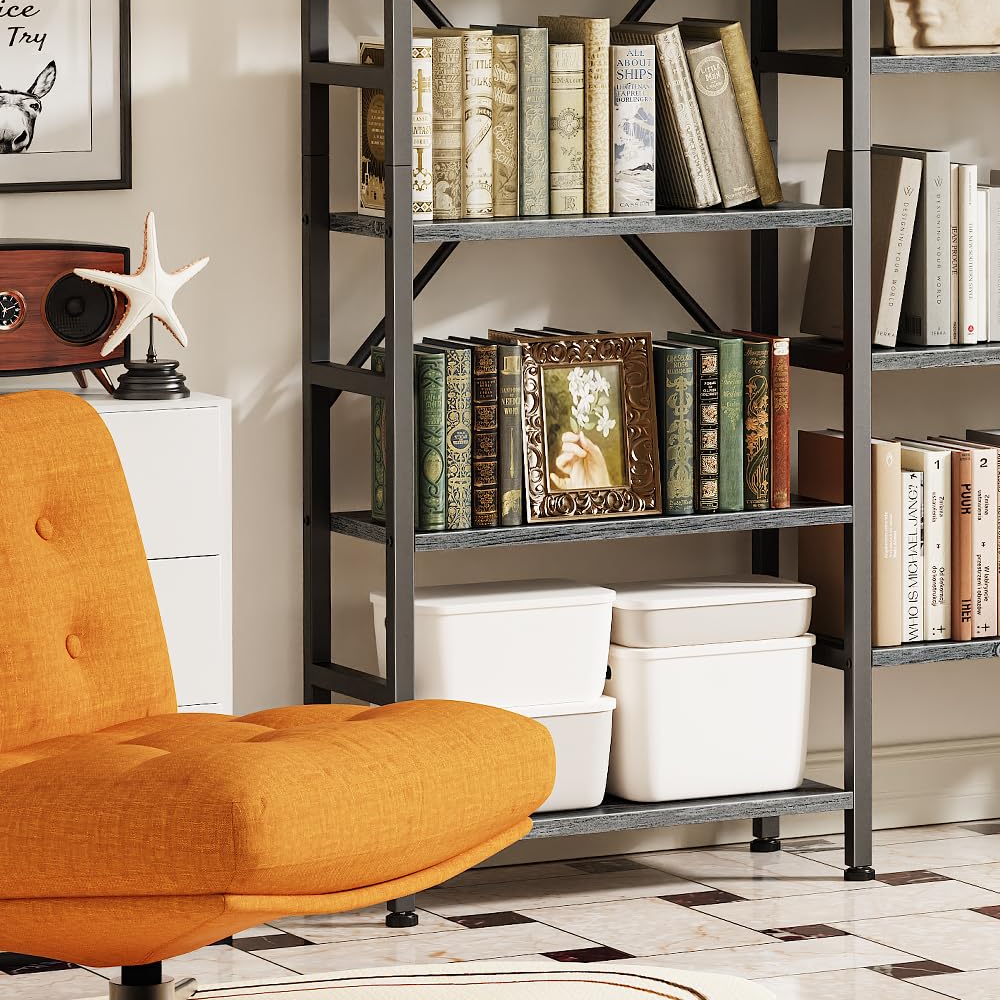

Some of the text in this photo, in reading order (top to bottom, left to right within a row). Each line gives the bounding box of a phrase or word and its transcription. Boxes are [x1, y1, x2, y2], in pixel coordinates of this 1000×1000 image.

[7, 26, 47, 52] Try
[626, 49, 645, 57] ALL
[616, 58, 653, 67] ABOUT
[616, 68, 653, 80] SHIPS
[888, 202, 910, 307] DESIGNING YOUR WORLD
[934, 459, 940, 470] 1
[980, 457, 988, 468] 2
[907, 484, 919, 642] WHO IS MICHAEL JANG?
